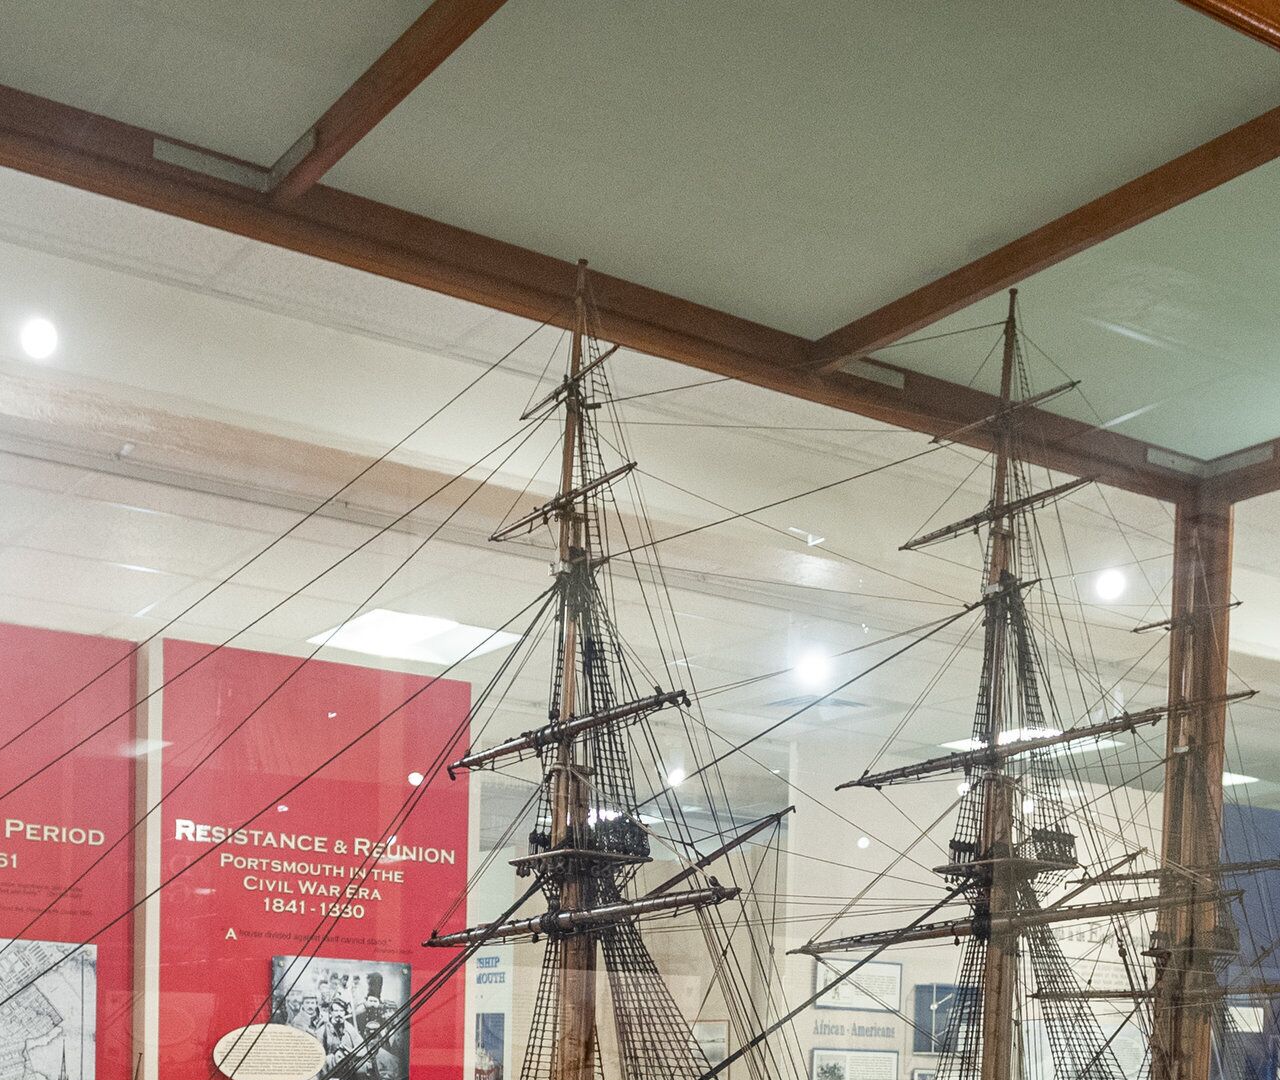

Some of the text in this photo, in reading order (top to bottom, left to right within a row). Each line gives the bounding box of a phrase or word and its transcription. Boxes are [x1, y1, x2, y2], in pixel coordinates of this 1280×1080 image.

[5, 818, 105, 846] PERIOD
[174, 818, 456, 865] RESISTANCE & REUNION
[220, 852, 345, 879] PORTSMOUTH
[371, 869, 404, 883] THE
[243, 875, 382, 901] CIVIL WAR ERA
[263, 897, 306, 915] 1841
